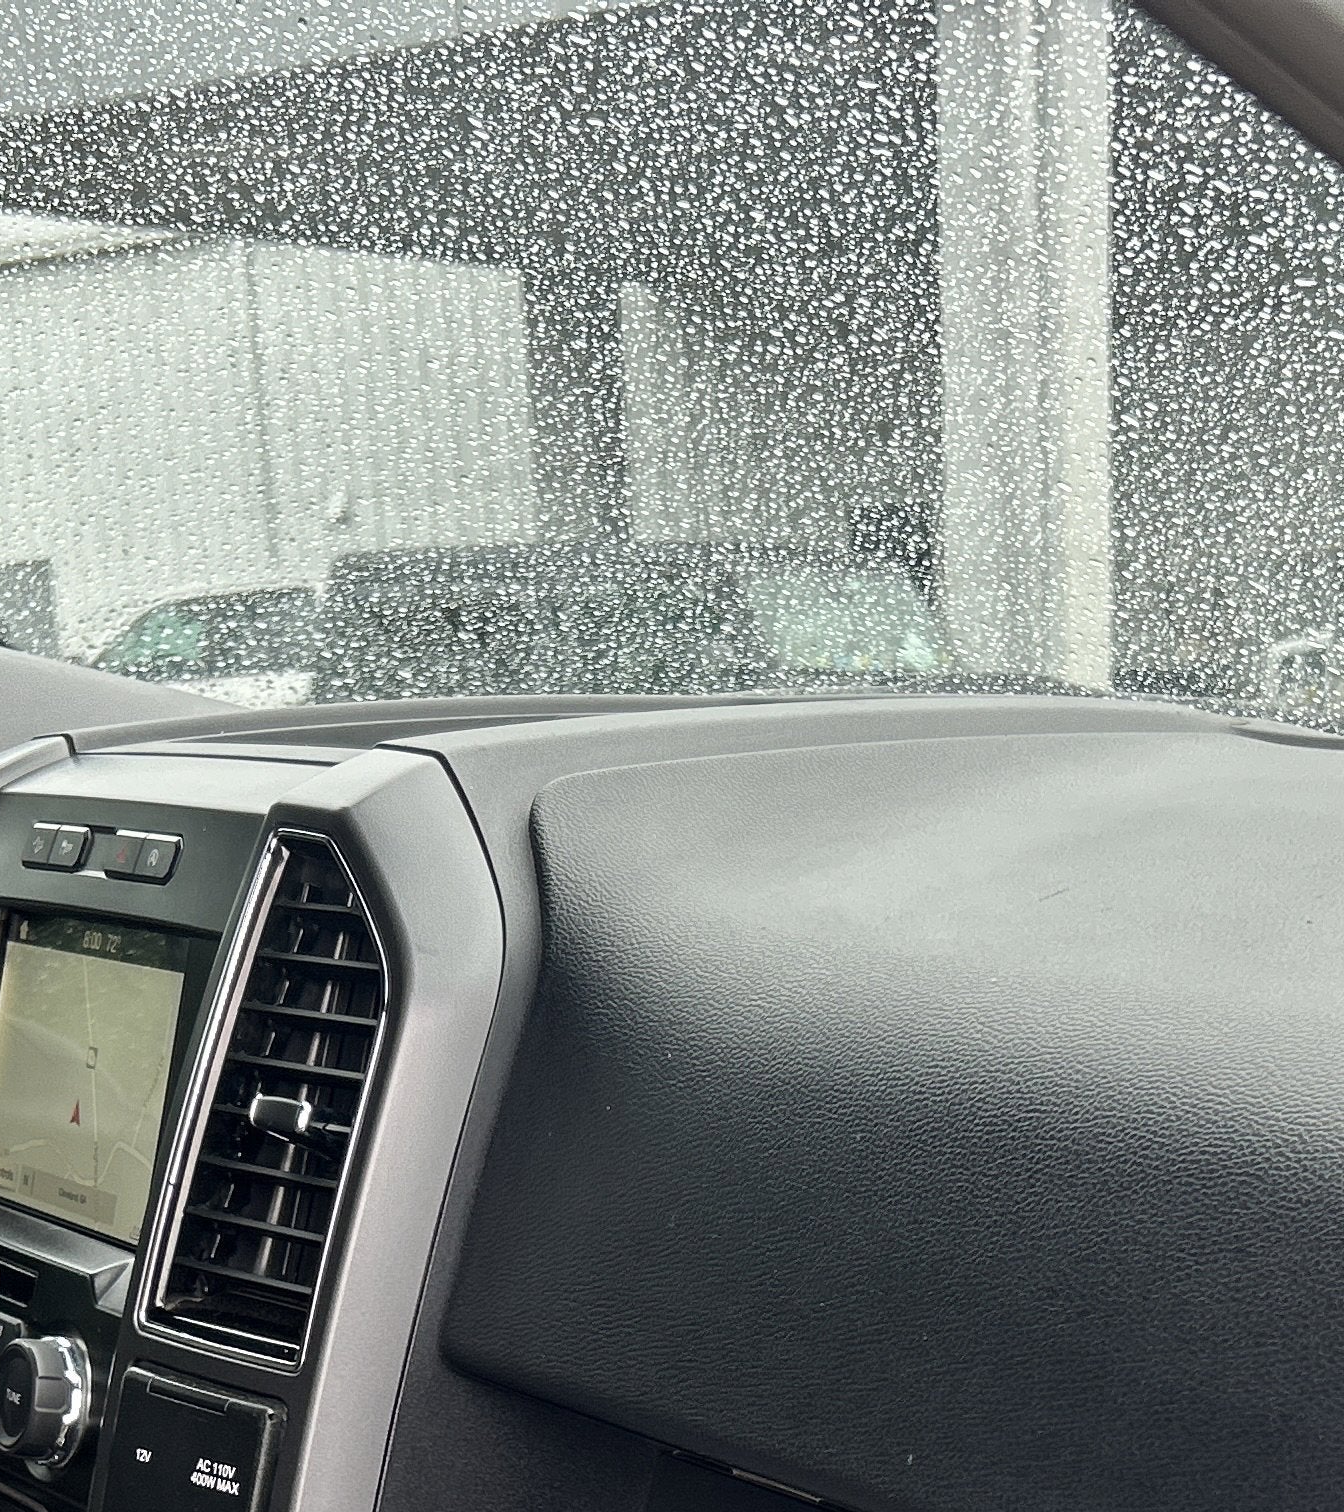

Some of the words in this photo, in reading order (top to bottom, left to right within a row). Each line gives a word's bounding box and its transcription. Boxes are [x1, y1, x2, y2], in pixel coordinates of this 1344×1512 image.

[6, 1387, 22, 1405] TUNE
[135, 1447, 153, 1463] 12V
[196, 1458, 212, 1473] AC
[212, 1462, 237, 1479] 110V
[190, 1471, 217, 1489] 400W
[216, 1478, 240, 1496] MAX
